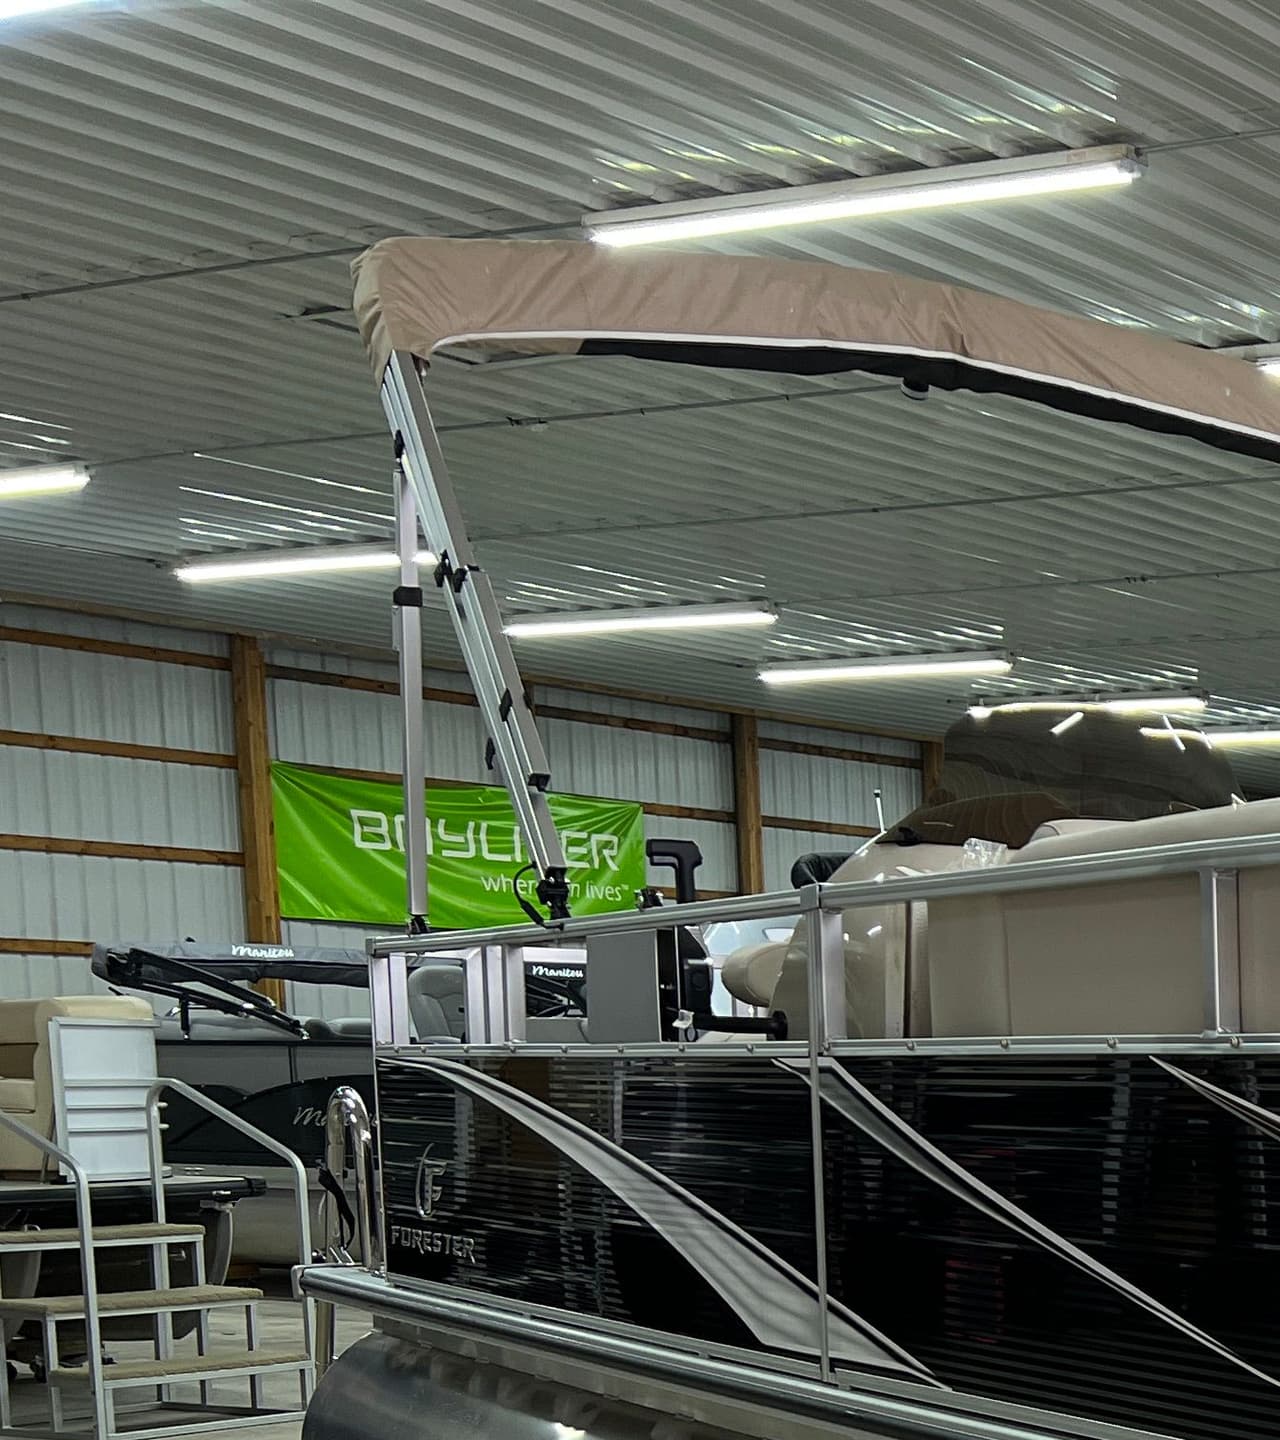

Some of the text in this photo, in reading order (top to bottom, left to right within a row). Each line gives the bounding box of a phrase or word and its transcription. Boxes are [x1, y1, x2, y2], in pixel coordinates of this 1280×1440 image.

[350, 809, 620, 872] BAYLIER
[232, 944, 295, 959] Manitou
[532, 964, 584, 978] Manitou
[391, 1225, 476, 1264] FORESTER
